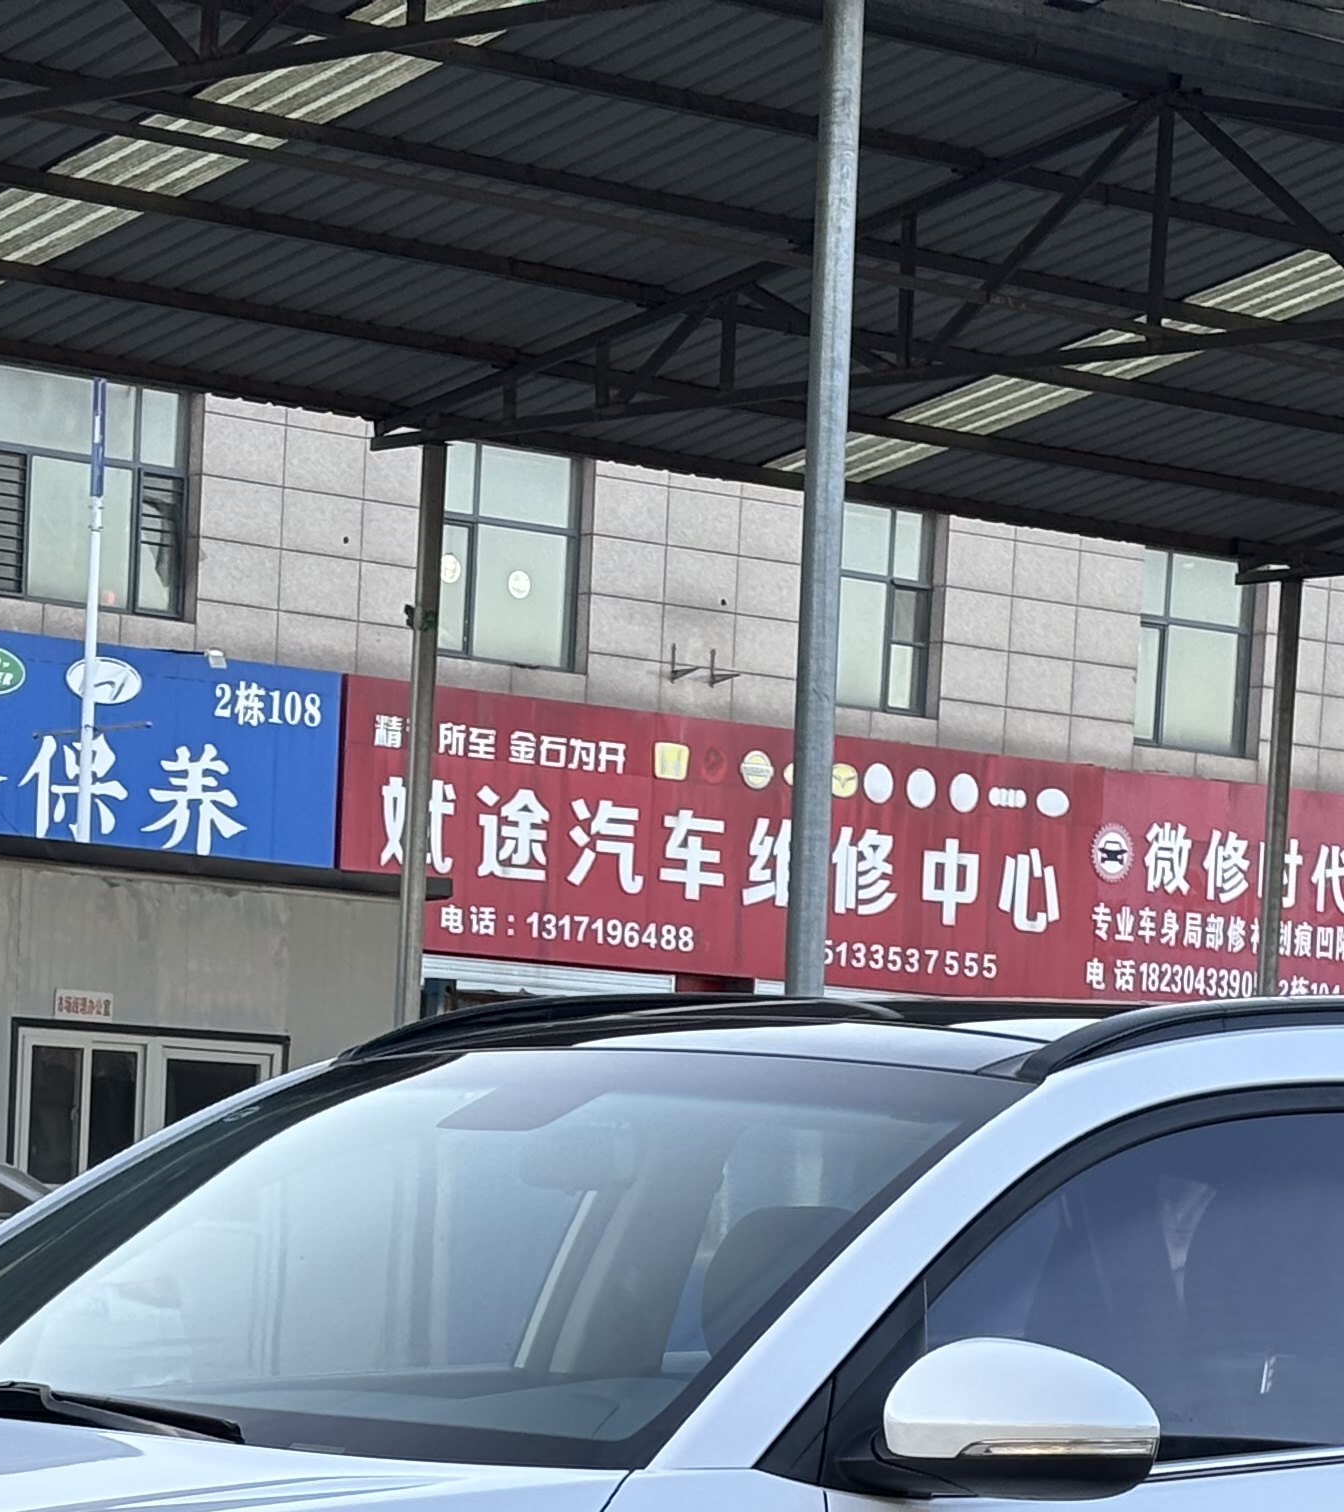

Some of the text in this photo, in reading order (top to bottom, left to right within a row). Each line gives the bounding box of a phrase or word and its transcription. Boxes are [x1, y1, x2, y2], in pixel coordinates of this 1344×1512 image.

[214, 680, 321, 727] 2栋108
[374, 714, 626, 774] 精所至 金石为开
[823, 939, 997, 979] 5133537555
[1084, 957, 1258, 998] 电话1823043390
